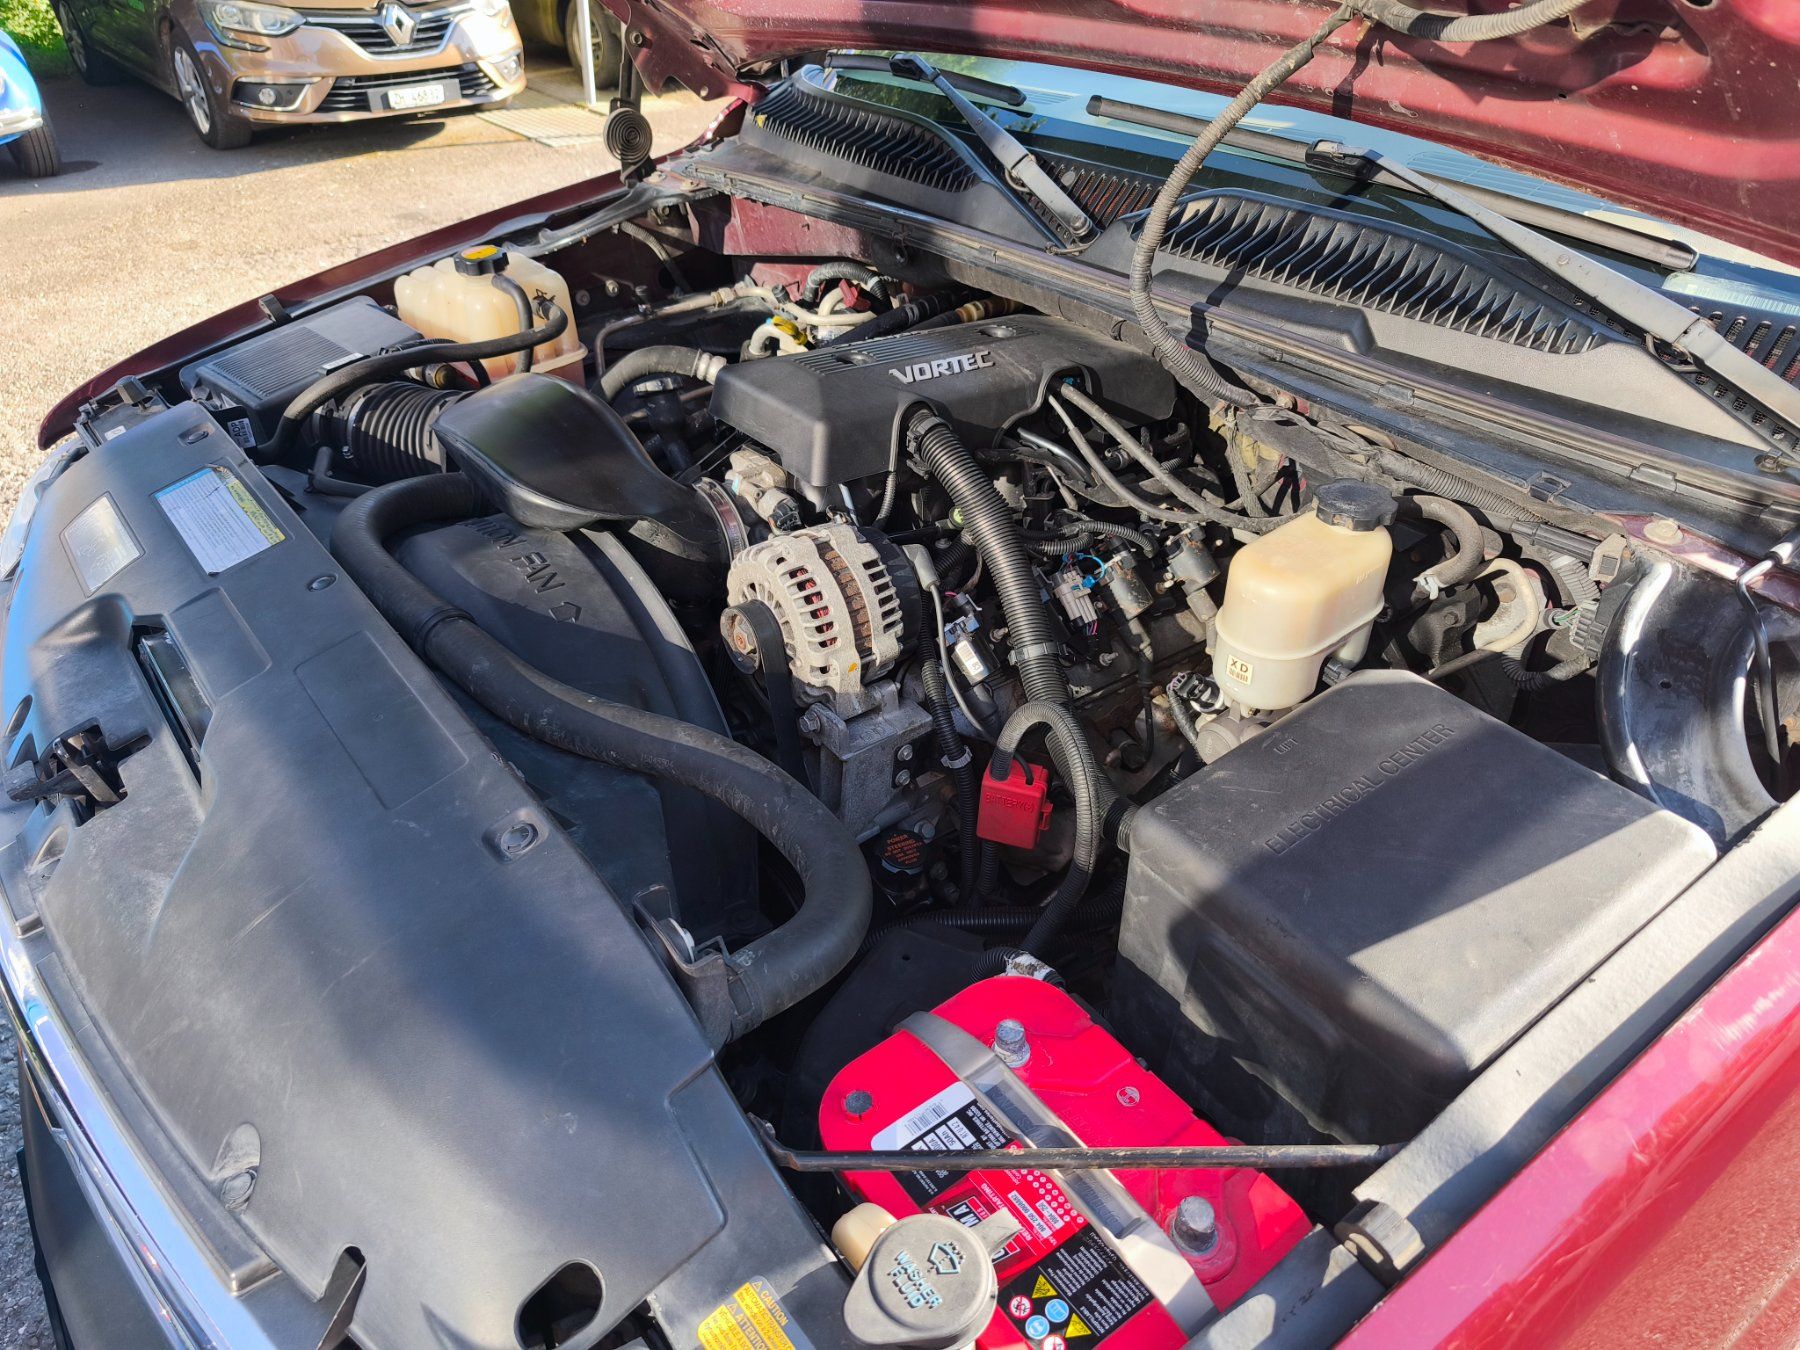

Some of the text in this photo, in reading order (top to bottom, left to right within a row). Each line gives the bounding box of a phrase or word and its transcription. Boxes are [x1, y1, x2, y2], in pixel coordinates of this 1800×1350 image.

[889, 350, 996, 385] VORTEC
[509, 551, 566, 594] FAN
[1264, 723, 1456, 856] ELECTRICAL CENTER
[887, 1265, 925, 1309] FLUID
[894, 1249, 942, 1309] WASHER
[760, 1290, 789, 1327] CAUTION
